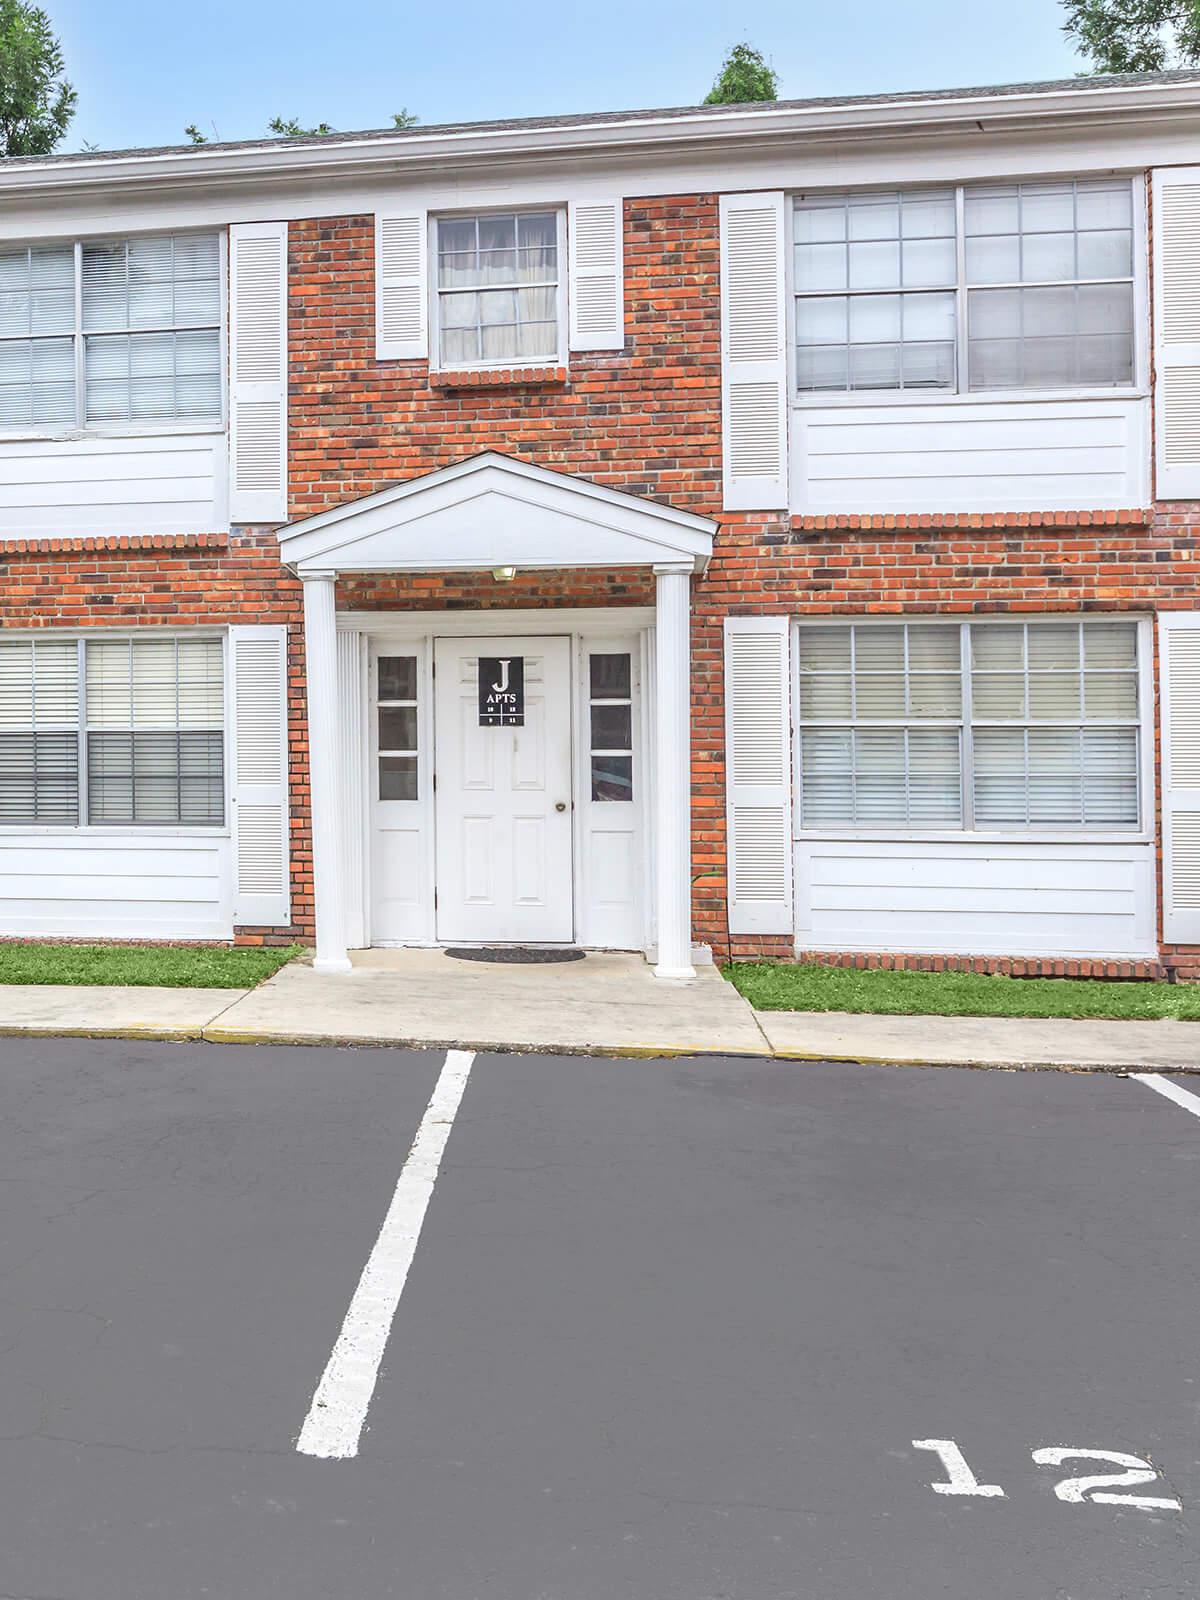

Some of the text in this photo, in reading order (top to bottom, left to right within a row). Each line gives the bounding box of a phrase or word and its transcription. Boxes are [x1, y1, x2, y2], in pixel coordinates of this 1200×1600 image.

[491, 660, 511, 692] J
[486, 693, 516, 703] APTS
[911, 1439, 1183, 1512] 12
